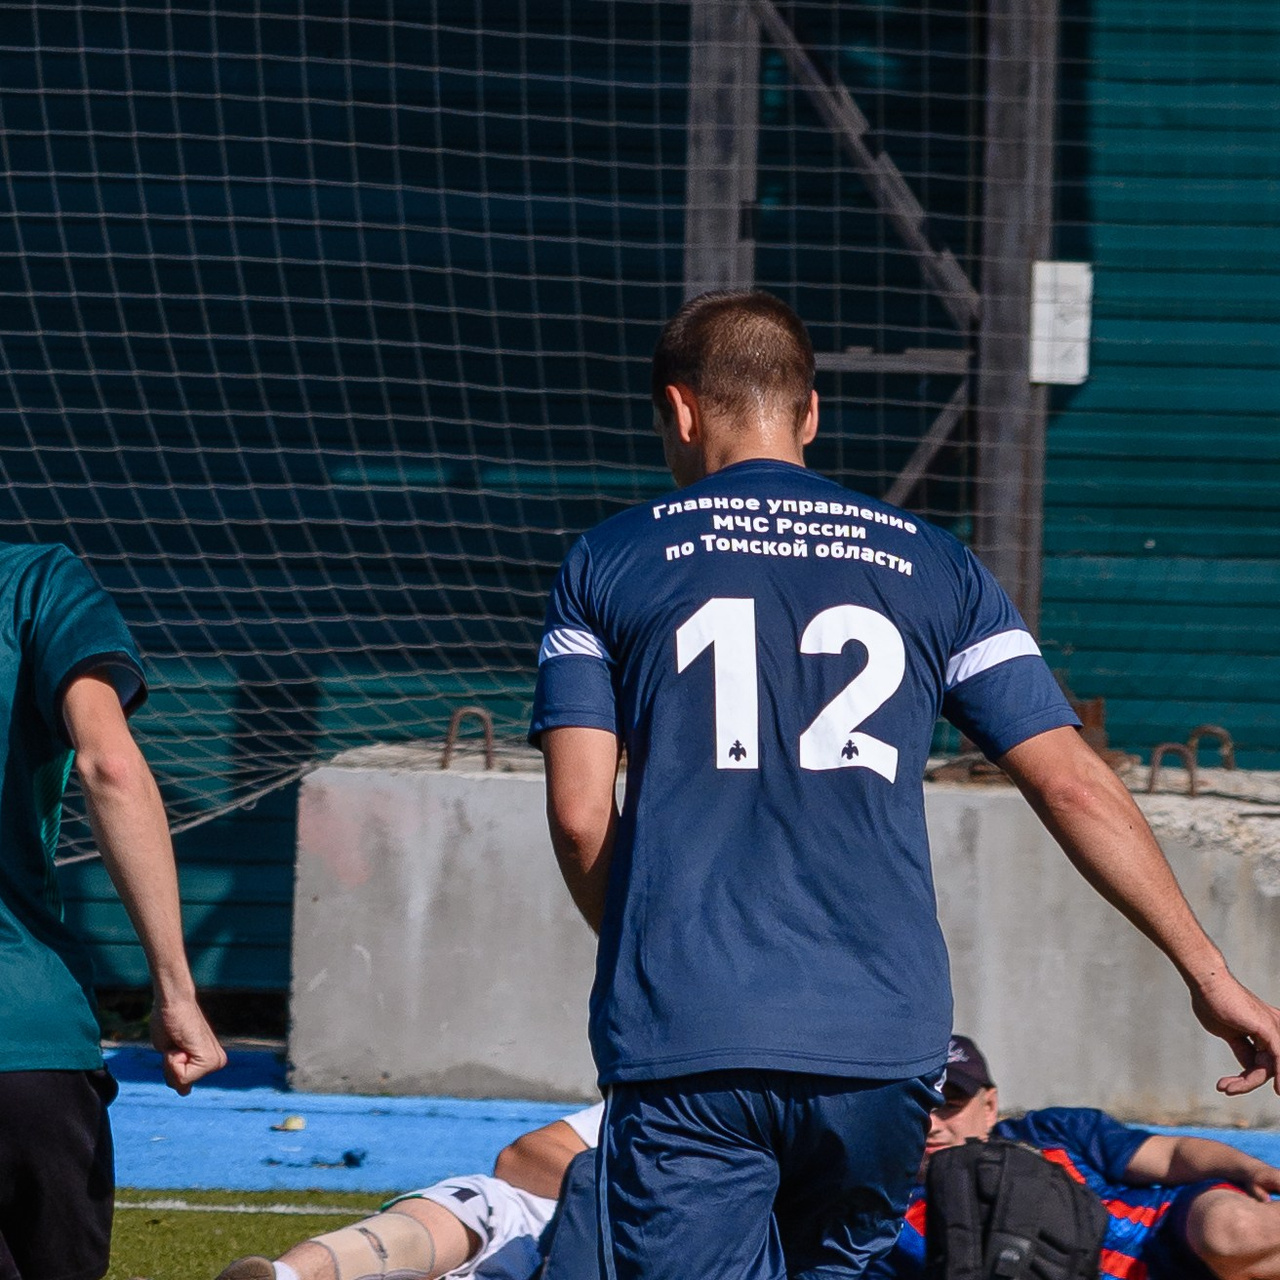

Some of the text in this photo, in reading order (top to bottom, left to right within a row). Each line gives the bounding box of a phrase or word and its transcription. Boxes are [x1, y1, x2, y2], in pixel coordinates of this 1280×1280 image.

[652, 497, 918, 535] Главное управление
[712, 515, 867, 539] МЧС России
[665, 534, 914, 576] по Томской области
[676, 597, 906, 784] 12
